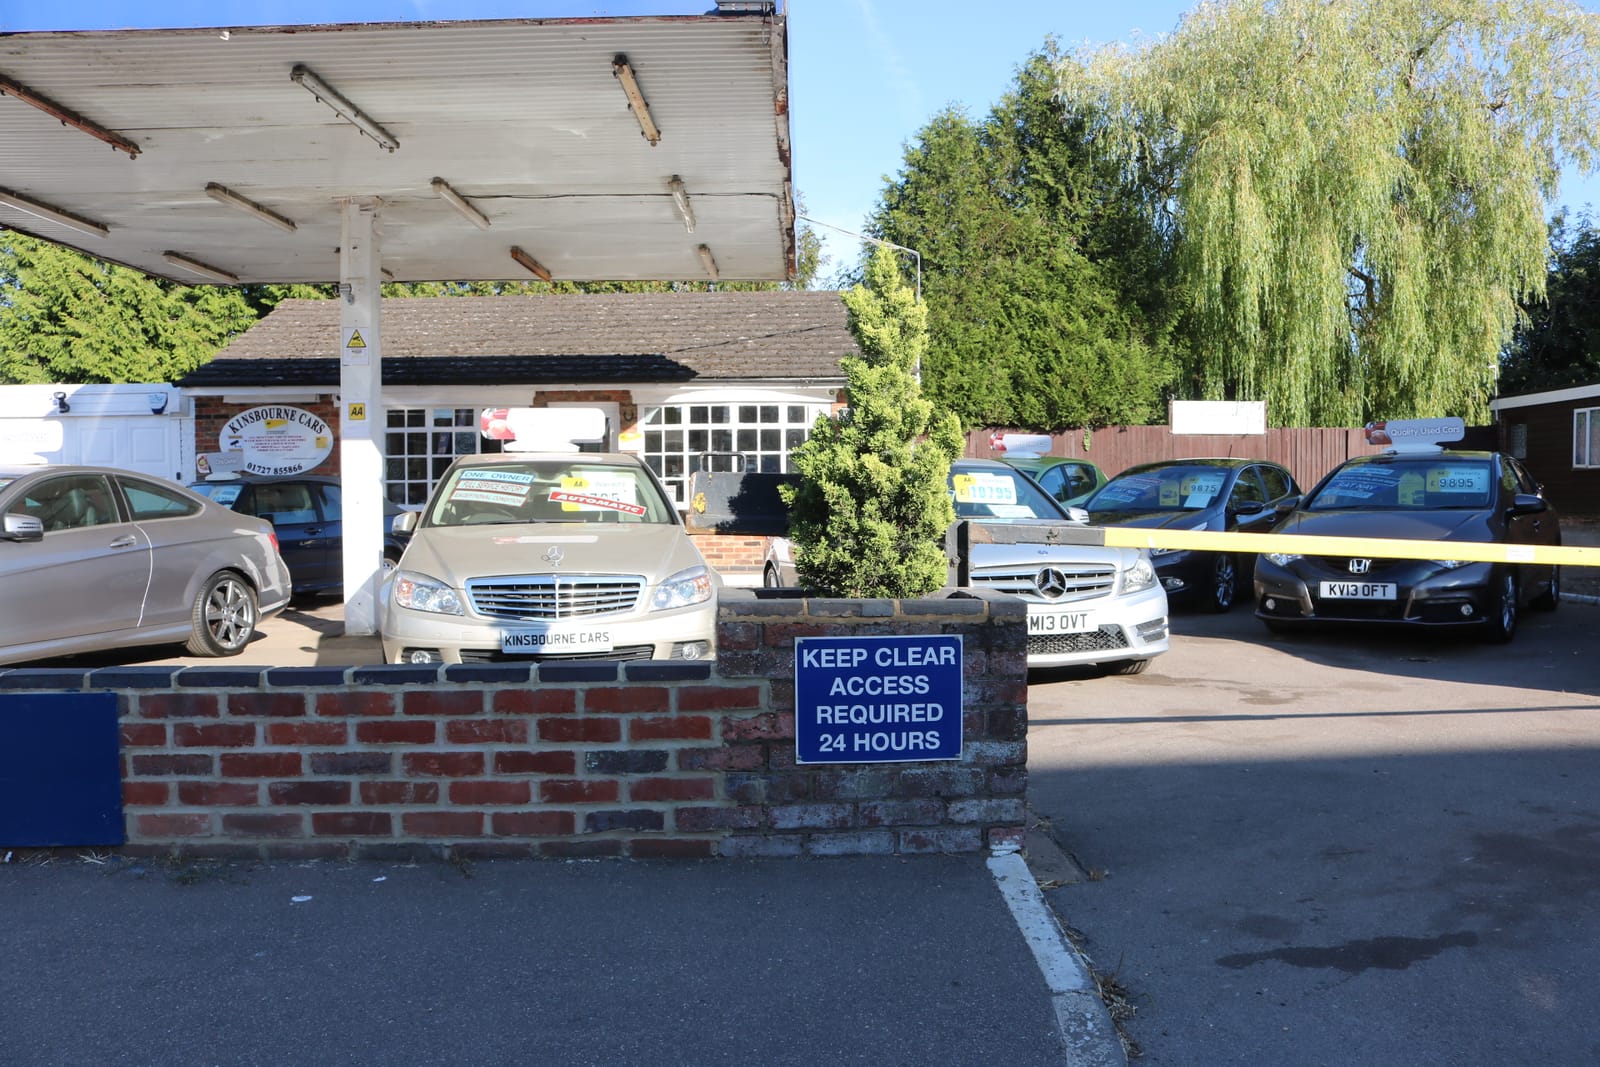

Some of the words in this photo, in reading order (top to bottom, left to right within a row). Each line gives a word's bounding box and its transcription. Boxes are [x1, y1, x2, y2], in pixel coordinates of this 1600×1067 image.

[351, 407, 363, 416] AA
[228, 407, 297, 434] KINSBOURNE
[298, 412, 326, 435] CARS
[1390, 427, 1418, 437] Quality
[1420, 426, 1441, 435] Used
[1442, 425, 1460, 434] Cars
[246, 462, 271, 474] 01727
[273, 465, 303, 475] 855866
[491, 473, 531, 481] OWNER
[1439, 478, 1474, 488] 9895
[970, 486, 1013, 499] 10795
[1191, 484, 1217, 493] 9875
[556, 494, 640, 513] AUTOMATIC
[1329, 584, 1358, 596] KV13
[1362, 585, 1388, 597] OFT
[1028, 615, 1055, 630] M13
[1060, 614, 1088, 629] OVT
[505, 634, 576, 646] KINSBOURNE
[580, 632, 610, 643] CARS
[803, 648, 868, 668] KEEP
[875, 646, 956, 667] CLEAR
[829, 675, 930, 696] ACCESS
[816, 703, 944, 725] REQUIRED
[819, 733, 847, 752] 24
[853, 731, 941, 752] HOURS
